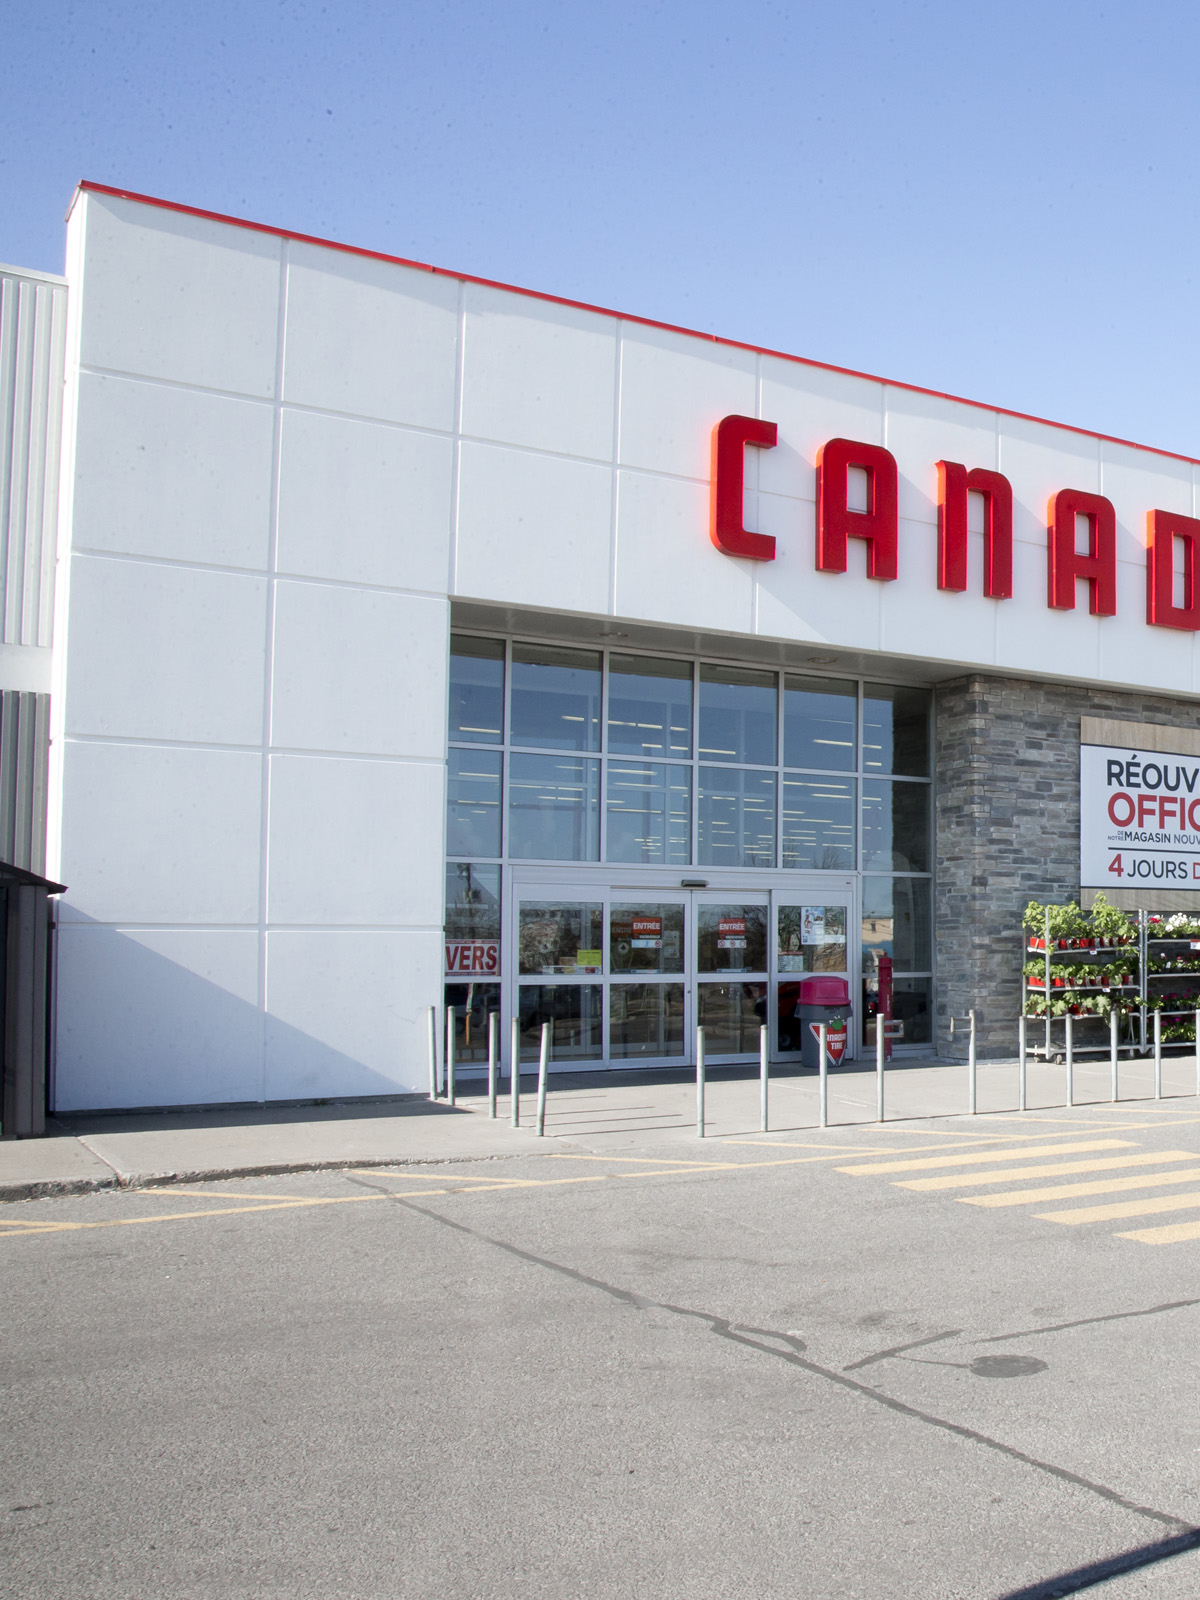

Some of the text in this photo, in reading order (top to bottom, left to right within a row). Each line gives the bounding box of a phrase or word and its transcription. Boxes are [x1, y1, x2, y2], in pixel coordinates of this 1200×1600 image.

[1124, 831, 1171, 844] MAGASIN
[1108, 853, 1124, 878] 4
[1127, 859, 1188, 880] JOURS
[633, 921, 661, 930] ENTRÉE
[719, 922, 745, 931] ENTRÉE
[445, 945, 498, 971] VERS
[830, 1041, 843, 1050] TIRE
